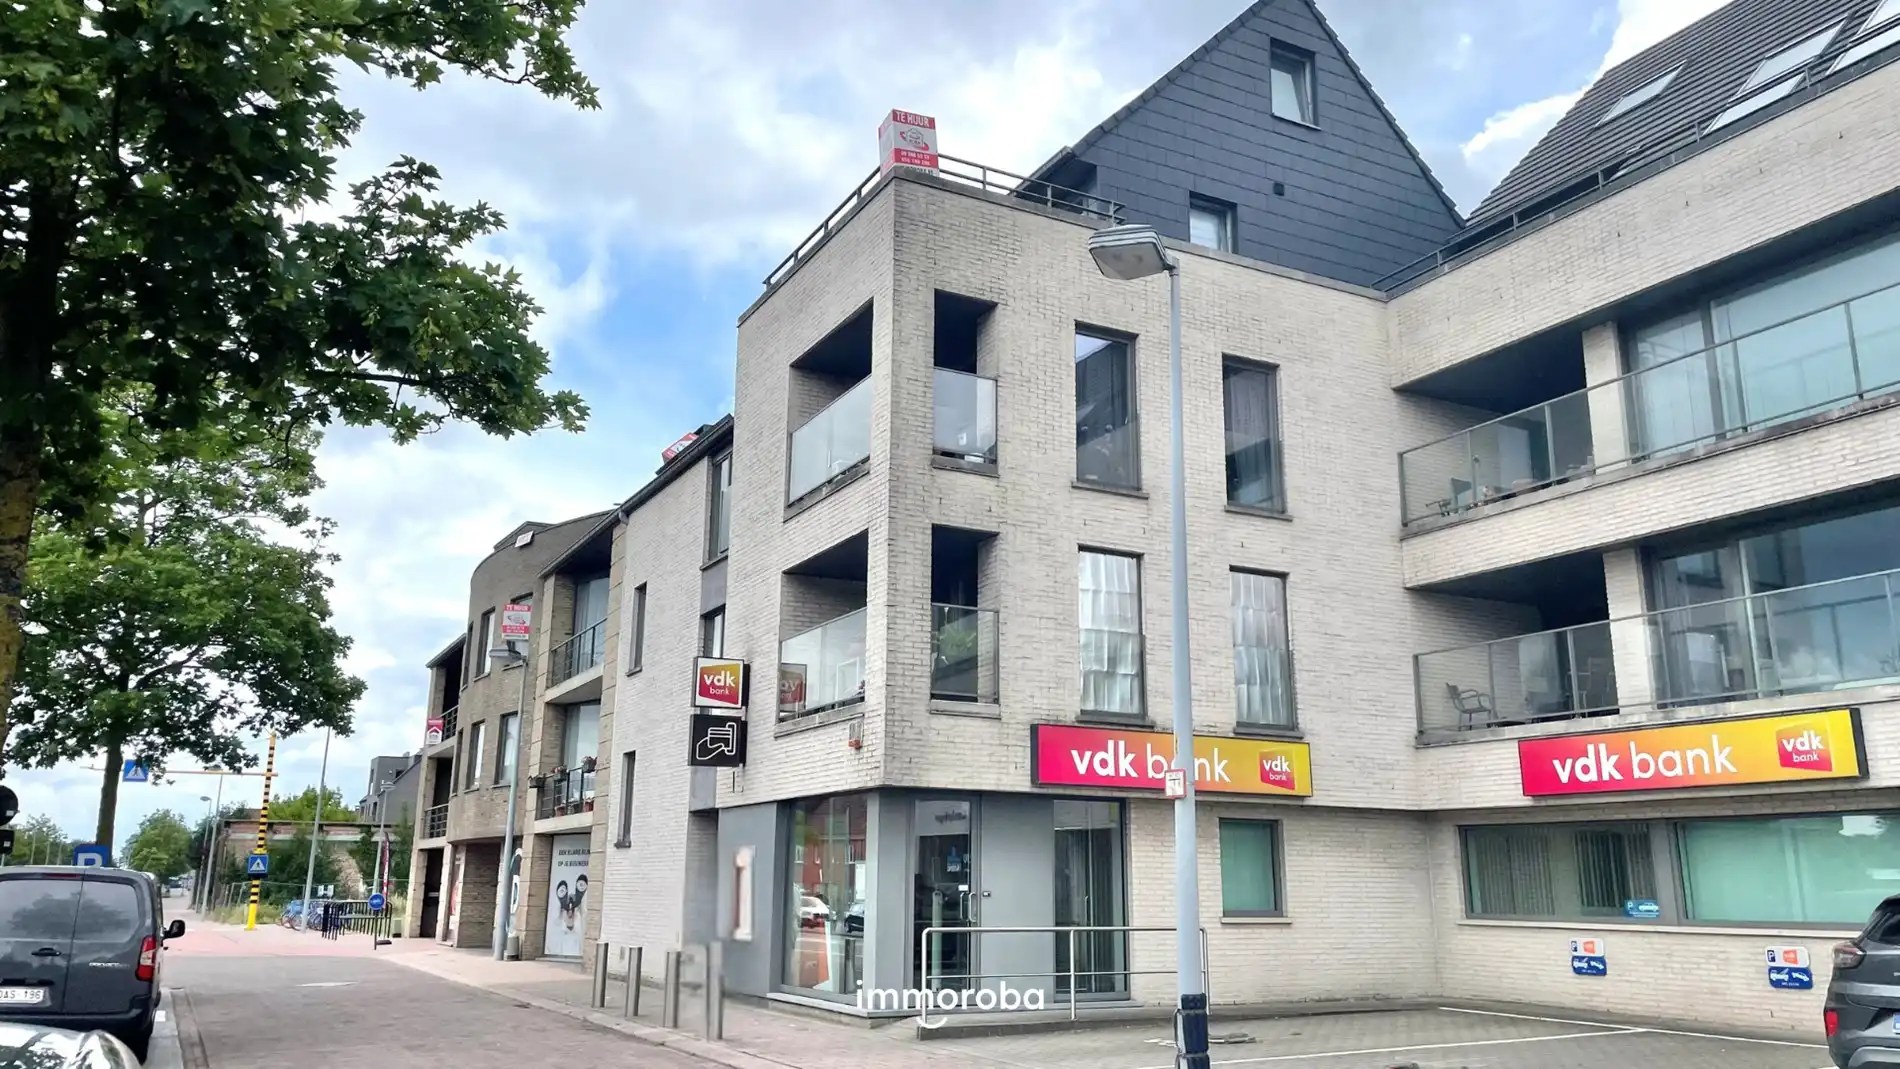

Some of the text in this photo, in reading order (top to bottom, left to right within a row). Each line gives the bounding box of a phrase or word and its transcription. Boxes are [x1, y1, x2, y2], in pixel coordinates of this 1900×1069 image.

[895, 111, 930, 128] TE HUUR
[704, 670, 735, 687] vdk
[710, 687, 729, 696] bank
[1782, 730, 1825, 753] vdk
[1070, 739, 1139, 778] vdk
[1263, 755, 1292, 773] vdk
[1552, 734, 1738, 784] vdk bank
[1792, 750, 1820, 763] bank
[1269, 772, 1288, 781] bank
[1768, 951, 1775, 961] P
